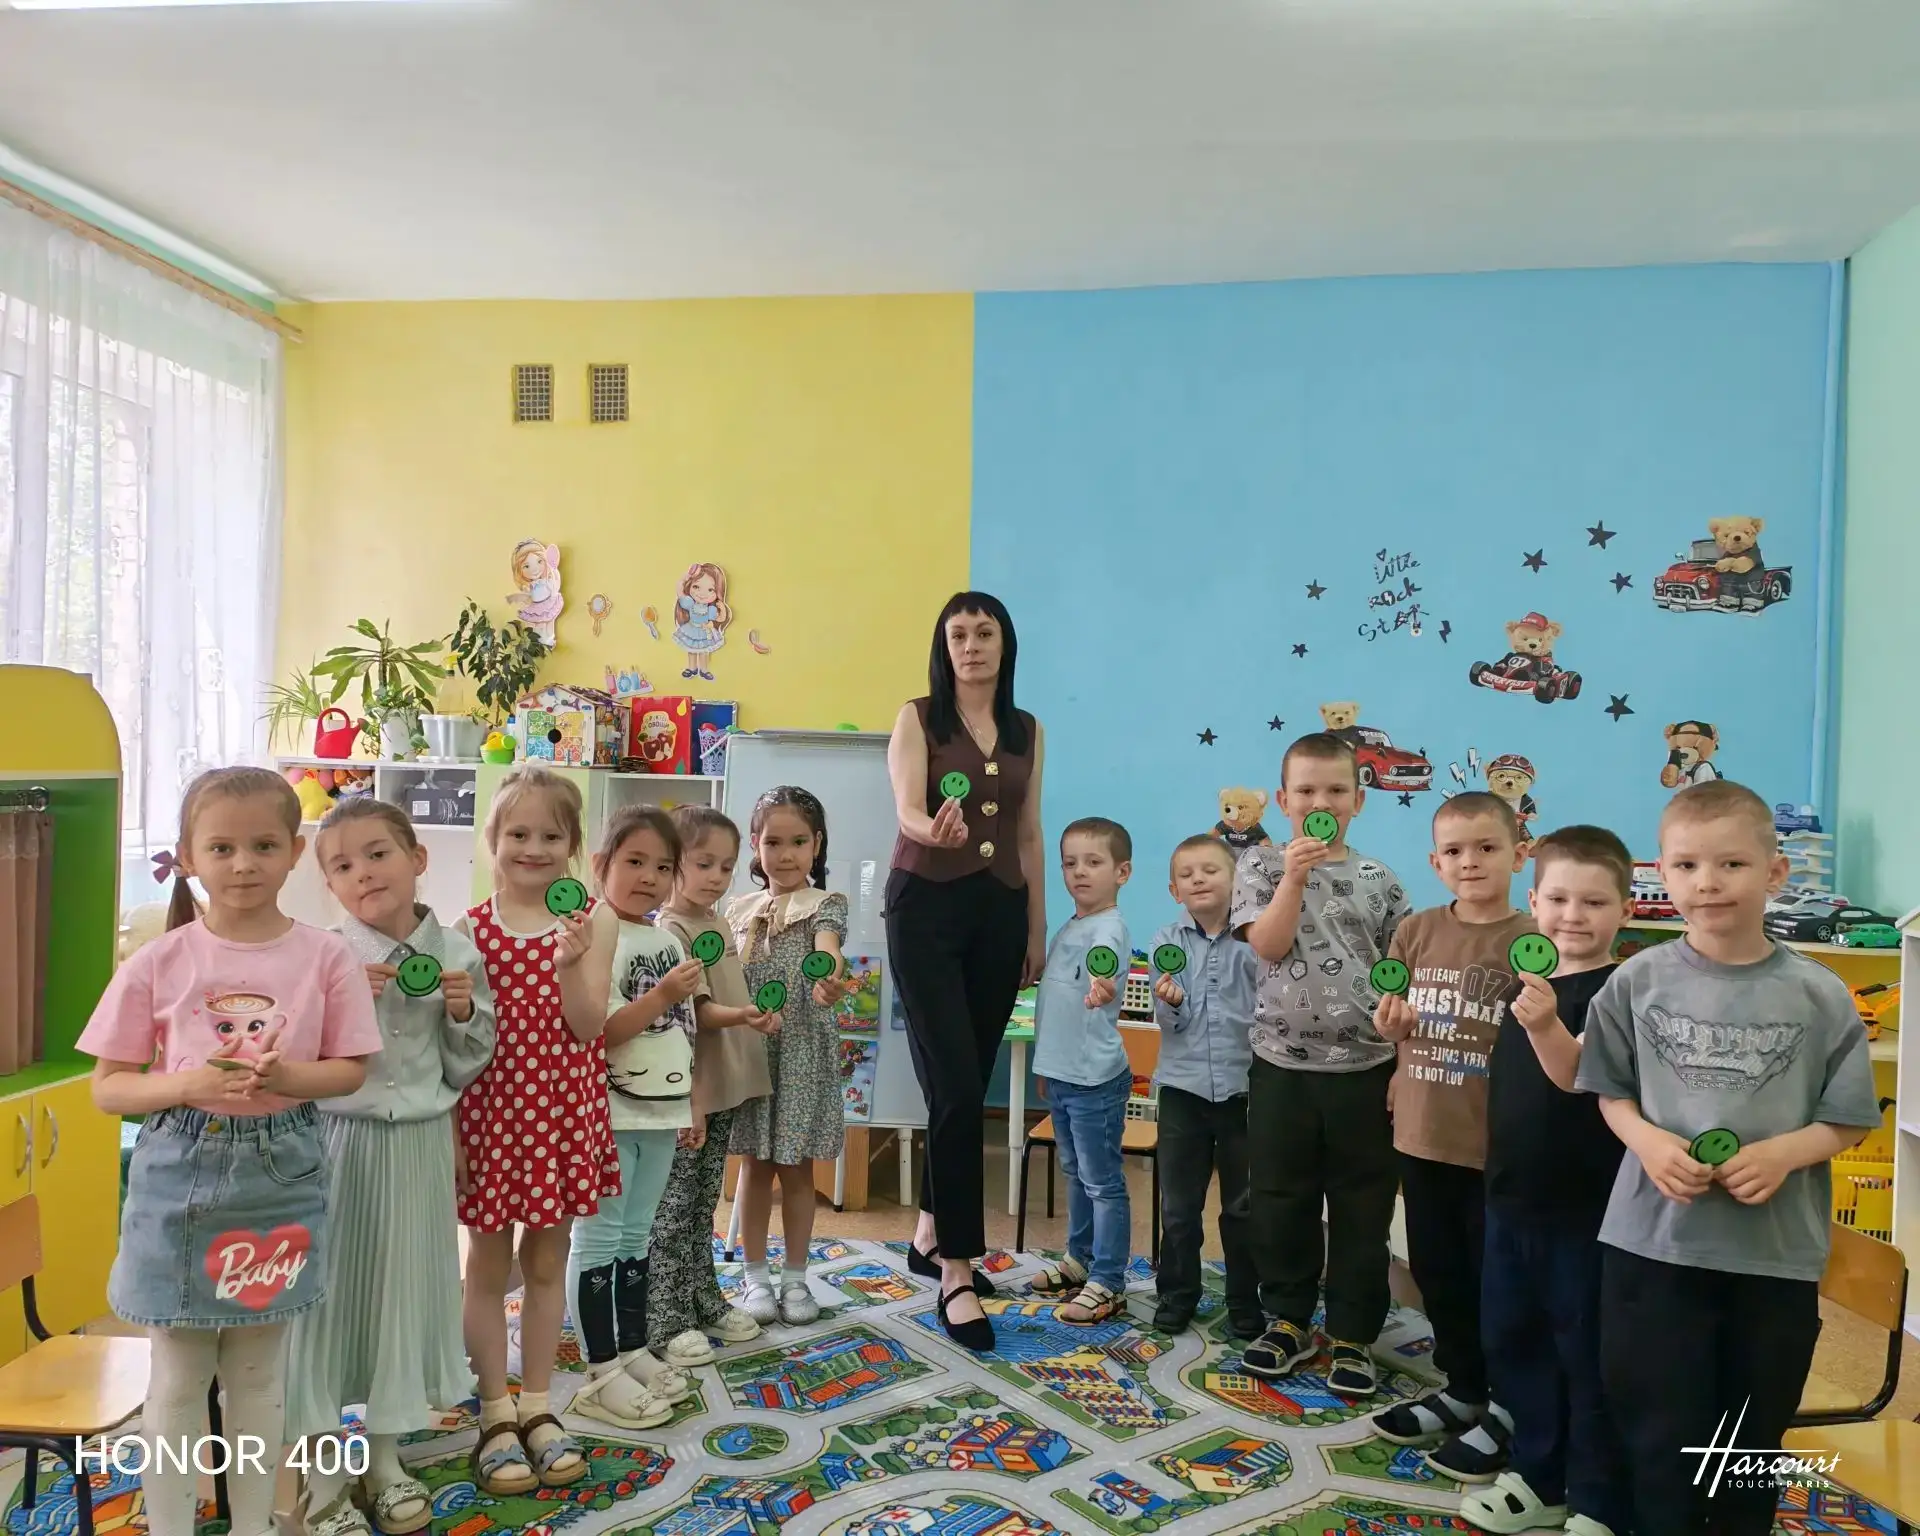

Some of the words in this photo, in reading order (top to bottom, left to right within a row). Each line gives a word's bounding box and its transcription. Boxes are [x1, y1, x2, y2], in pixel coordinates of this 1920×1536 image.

[1414, 967, 1431, 982] NOT
[1460, 963, 1513, 1010] 07
[1424, 1067, 1445, 1083] NOT
[216, 1240, 307, 1299] Baby
